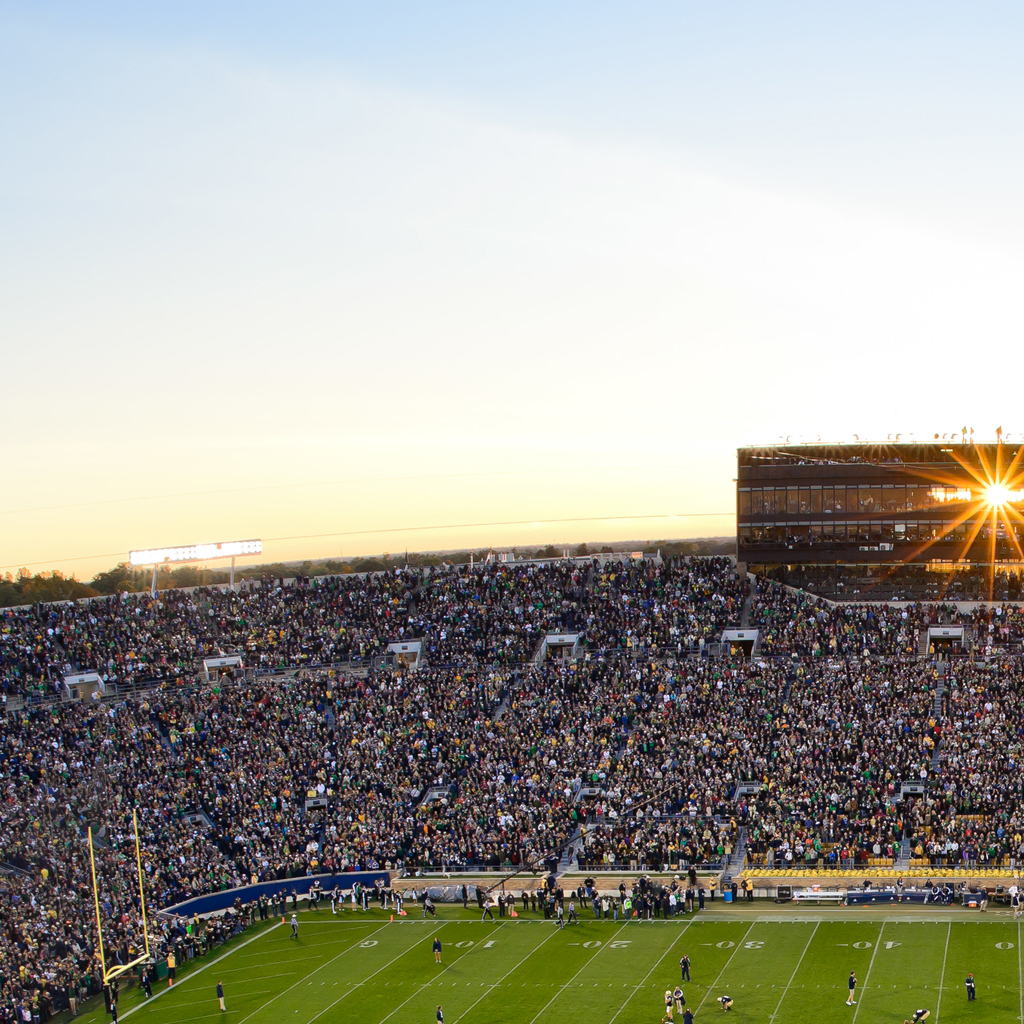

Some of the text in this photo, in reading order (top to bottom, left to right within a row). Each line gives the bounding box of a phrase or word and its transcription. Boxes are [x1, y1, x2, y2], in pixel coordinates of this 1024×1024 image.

[582, 940, 632, 949] 20
[716, 941, 765, 949] 30
[853, 941, 903, 949] 40
